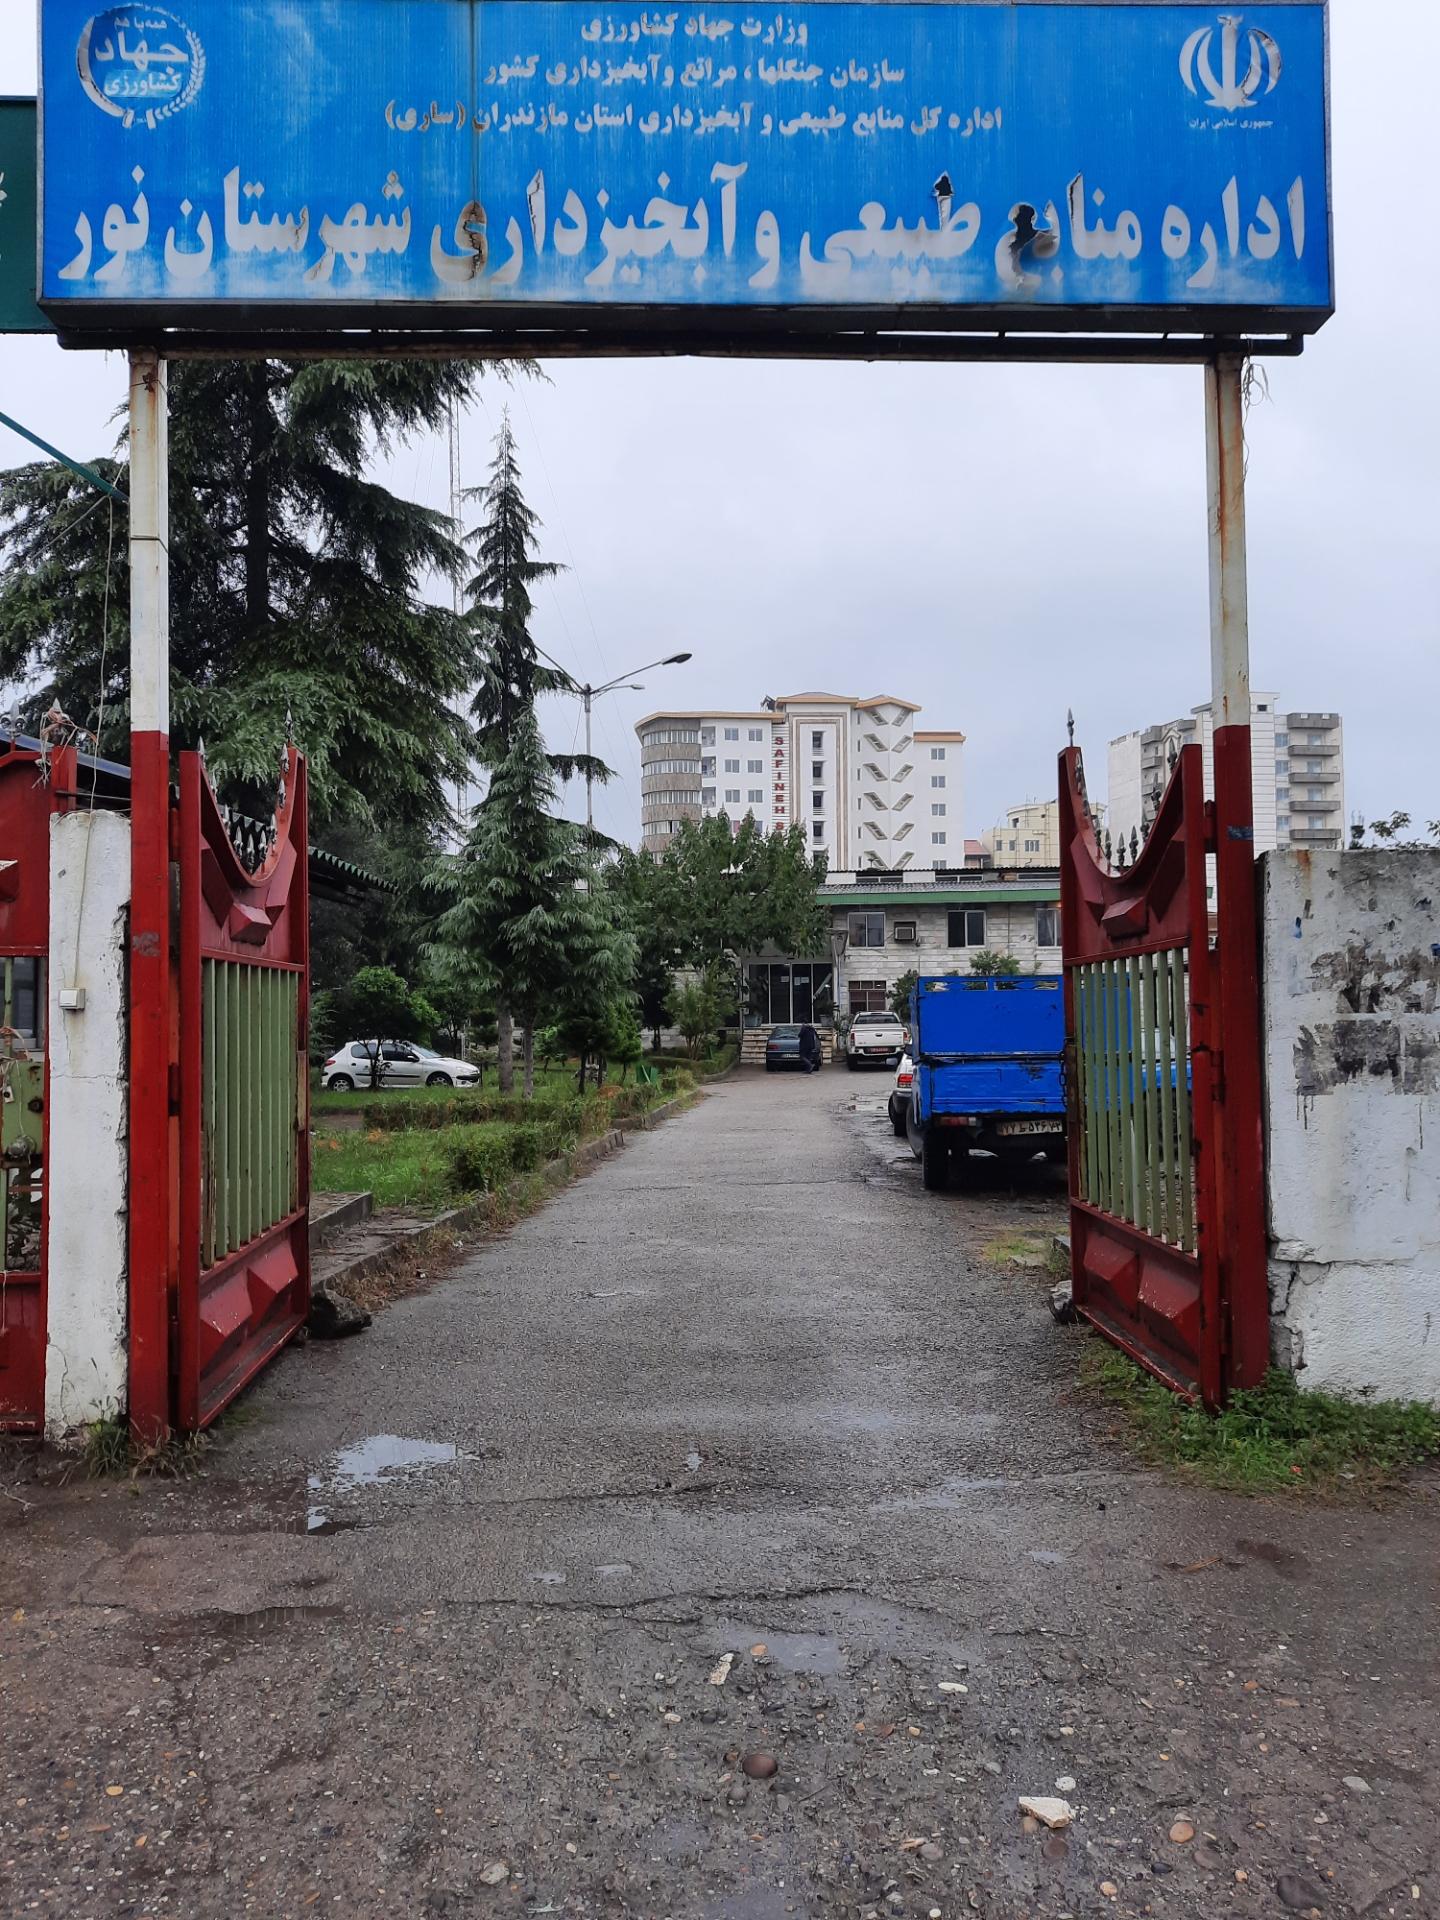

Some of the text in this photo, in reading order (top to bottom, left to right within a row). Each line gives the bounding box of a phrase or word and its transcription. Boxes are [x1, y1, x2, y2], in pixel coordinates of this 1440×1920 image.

[581, 13, 808, 44] وزارت جهاد کشاورزی
[94, 31, 189, 75] جهاد
[103, 71, 182, 96] کشاورزی
[484, 55, 540, 85] کشور
[680, 57, 737, 88] مراتع
[830, 59, 905, 88] سازمان
[472, 102, 569, 133] مازندران
[573, 103, 634, 134] استان
[638, 101, 754, 135] آبخیزداری
[760, 113, 774, 135] و
[778, 105, 846, 136] طبیعی
[852, 106, 905, 136] منابع
[910, 106, 942, 135] کل
[948, 106, 1002, 137] اداره
[57, 164, 150, 280] نور
[163, 166, 411, 282] شهرستان
[799, 168, 982, 296] طبیعی
[994, 168, 1143, 288] منابع
[1161, 174, 1306, 289] اداره
[774, 735, 786, 815] SAFINEH
